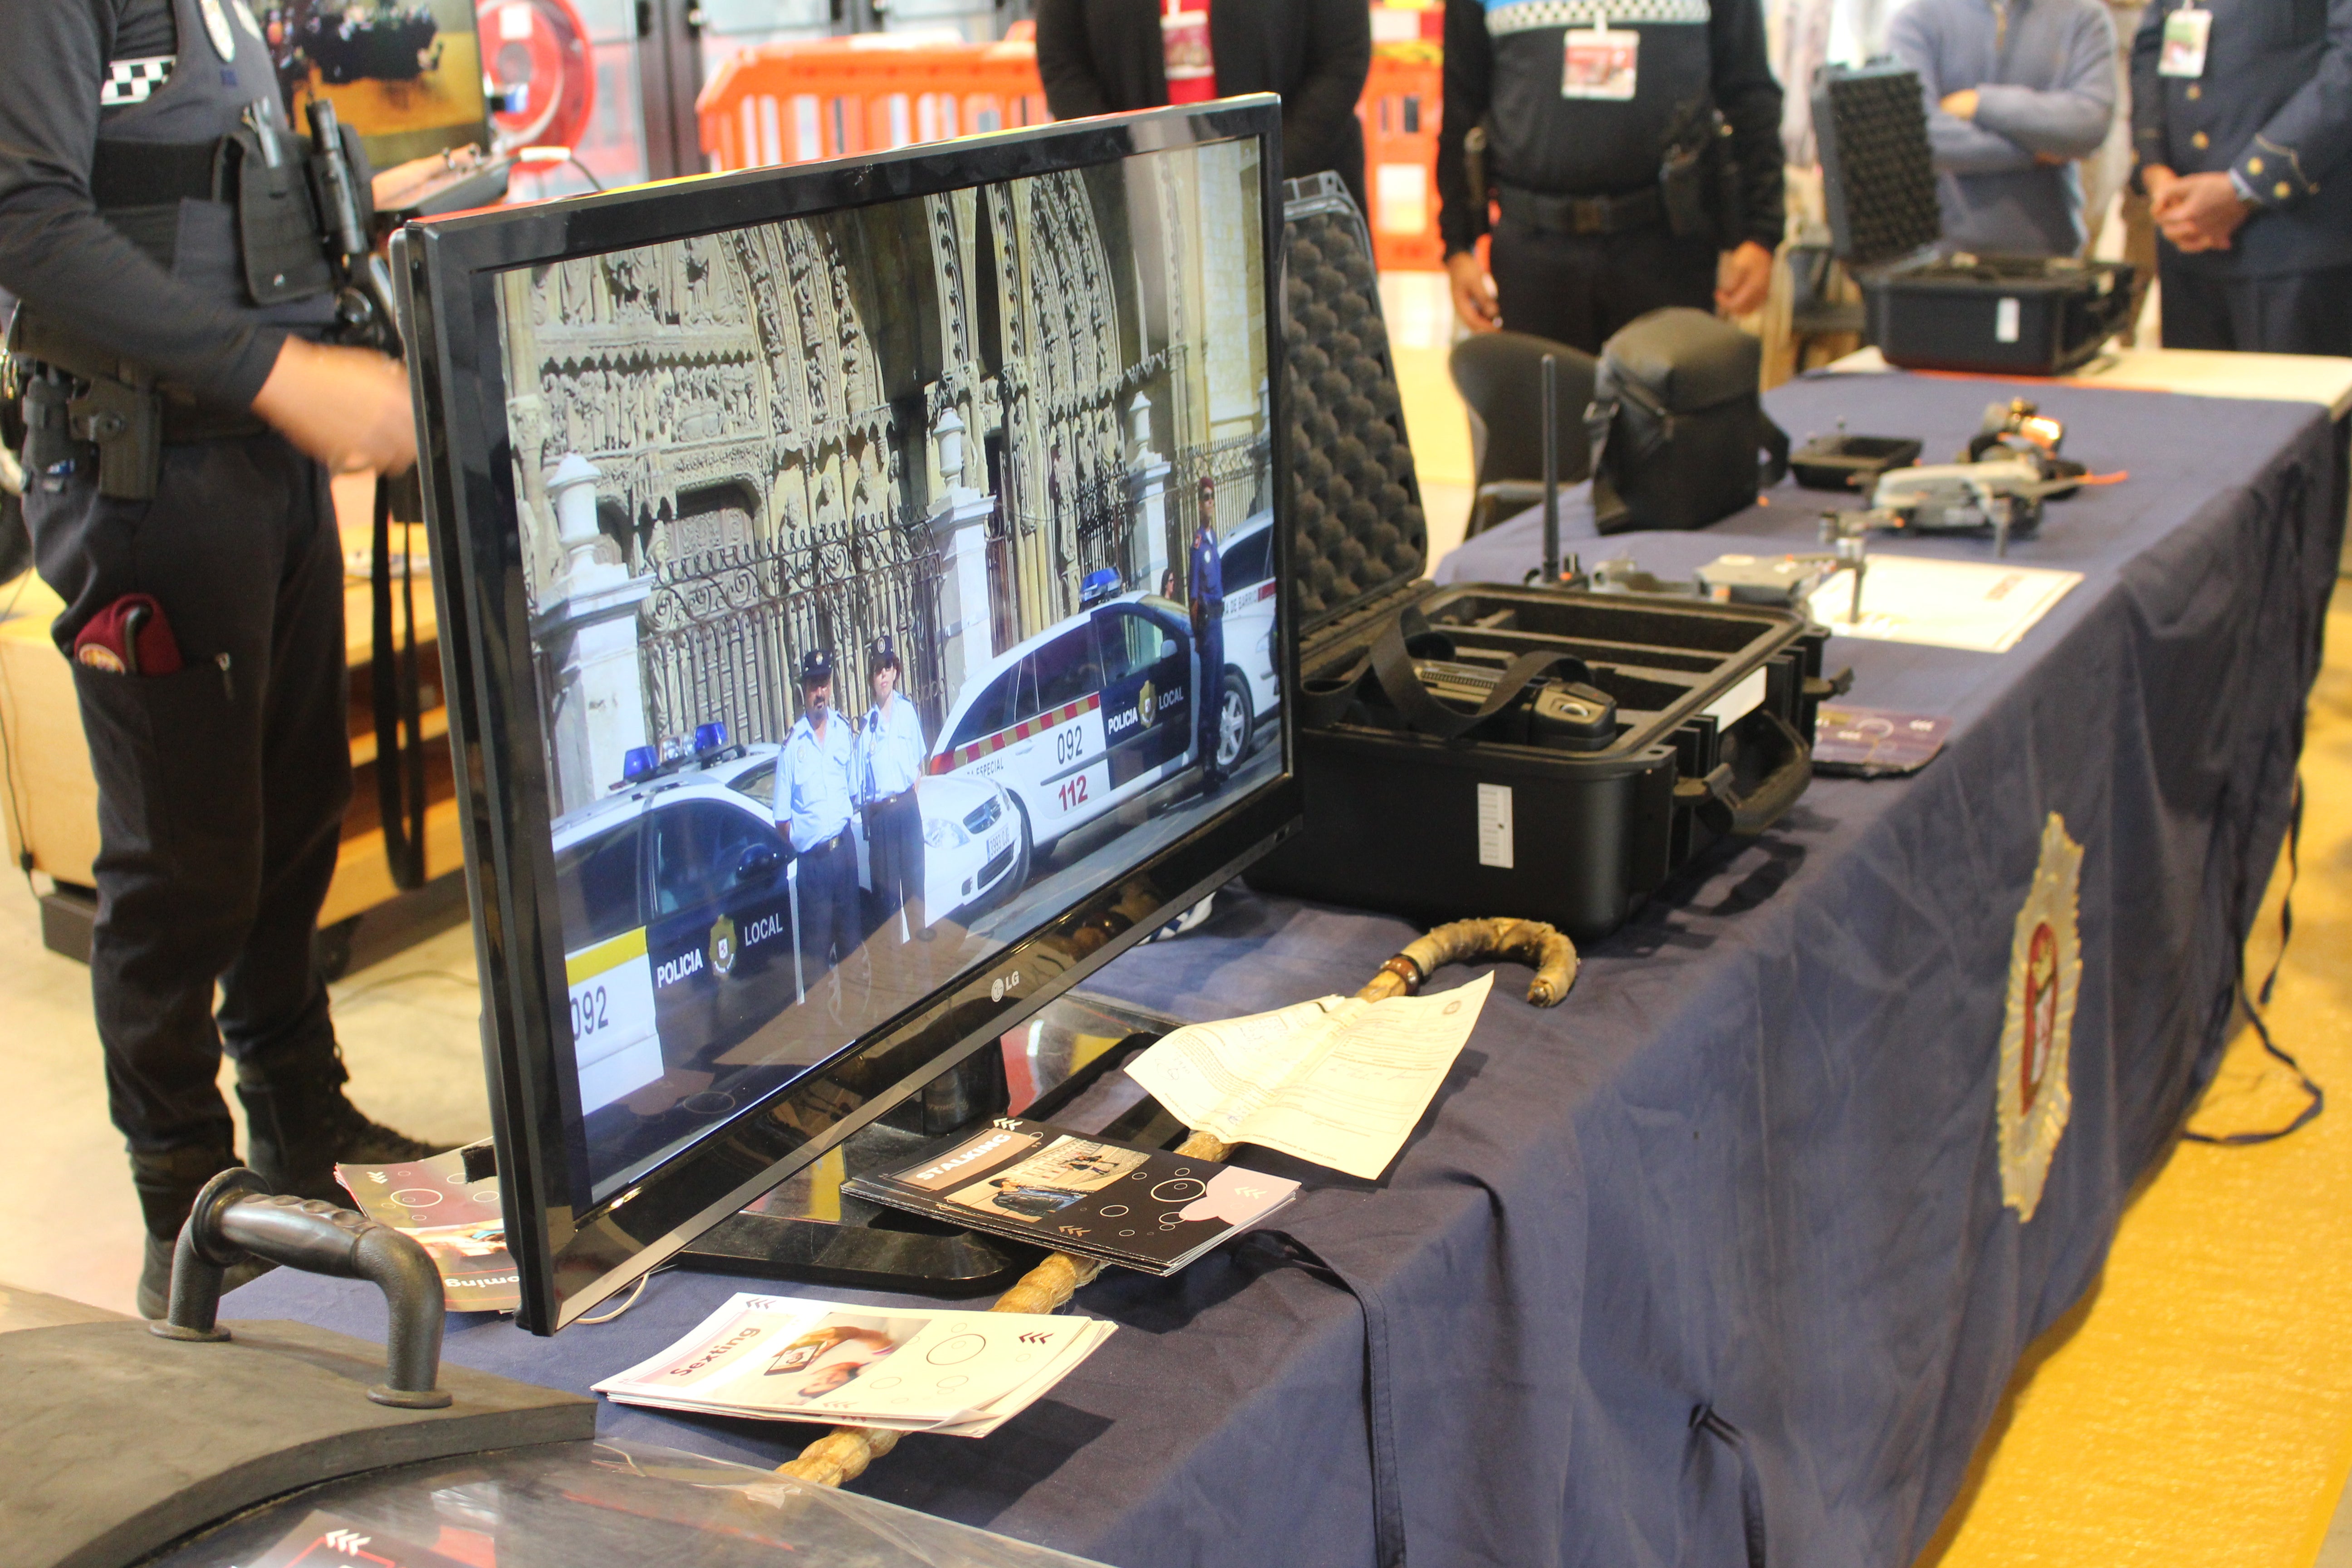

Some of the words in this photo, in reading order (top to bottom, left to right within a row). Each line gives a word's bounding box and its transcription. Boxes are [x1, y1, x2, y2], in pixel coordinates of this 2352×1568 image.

[1108, 707, 1138, 735] POLICIA
[1159, 686, 1184, 710] LOCAL
[1057, 725, 1083, 764] 092
[1058, 775, 1088, 811] 112
[657, 948, 704, 988] POLICIA
[744, 913, 783, 947] LOCAL
[1005, 970, 1020, 991] LG
[916, 1133, 1012, 1181] STALKING
[670, 1327, 761, 1377] Sexting
